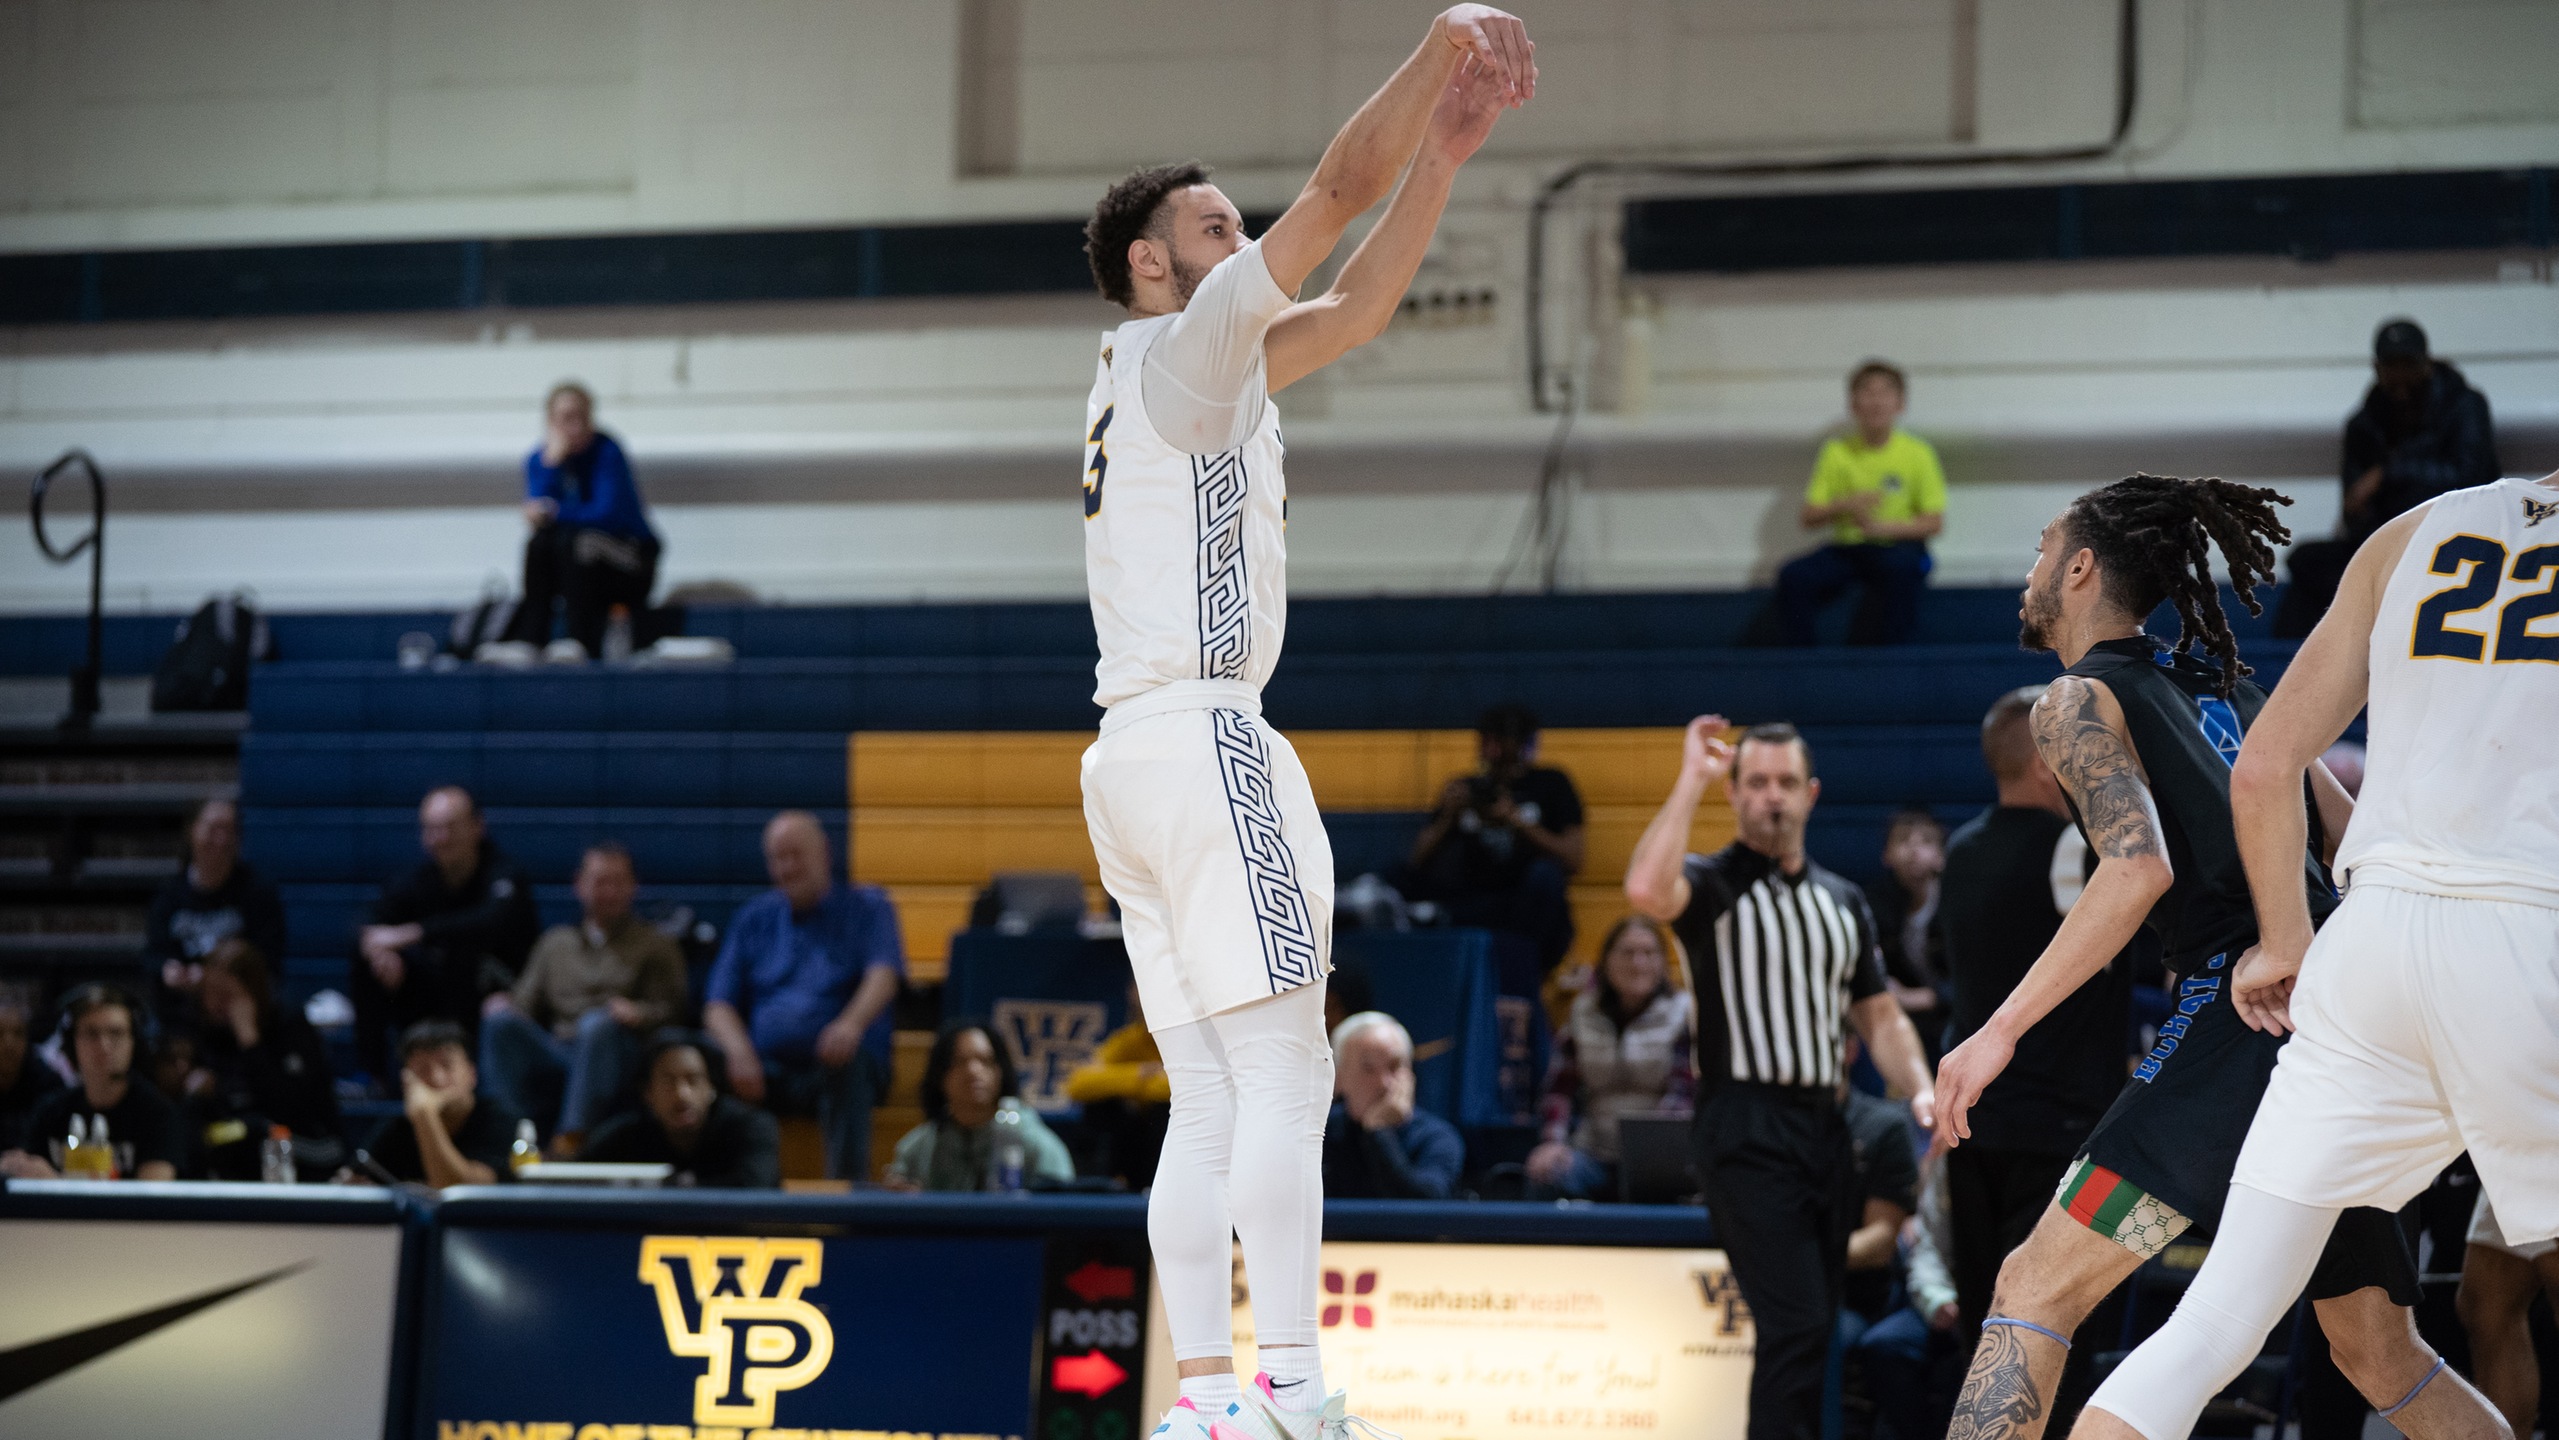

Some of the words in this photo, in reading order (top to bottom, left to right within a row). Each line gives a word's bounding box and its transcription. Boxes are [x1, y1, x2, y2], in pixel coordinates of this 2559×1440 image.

[2409, 532, 2559, 664] 22
[639, 1236, 834, 1426] WP
[1052, 1308, 1138, 1346] POSS
